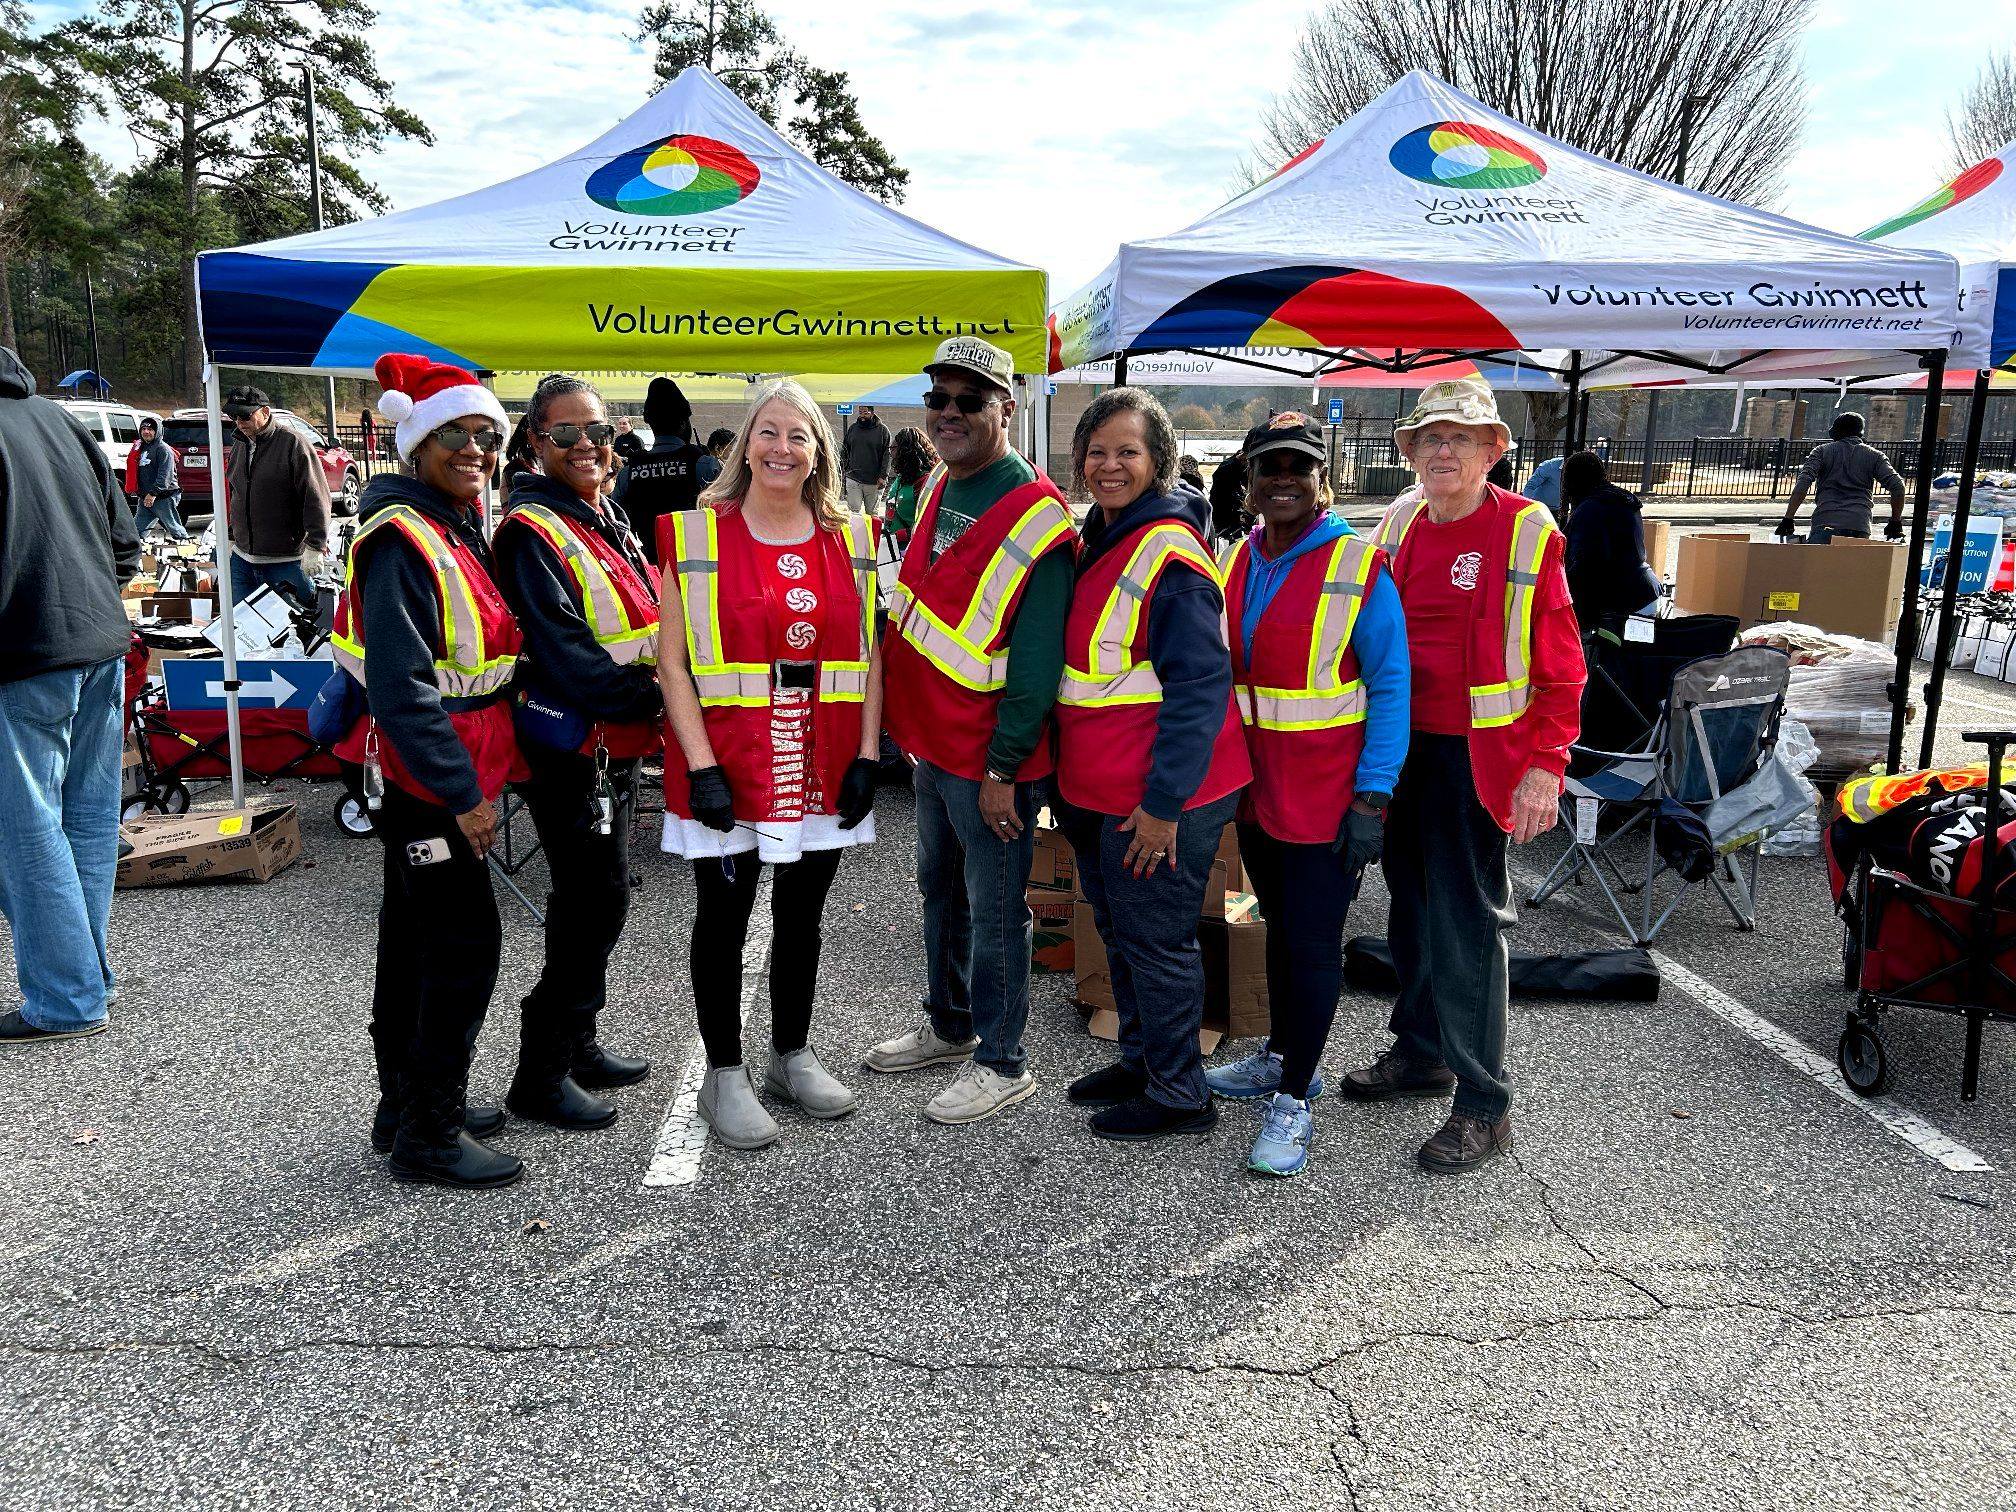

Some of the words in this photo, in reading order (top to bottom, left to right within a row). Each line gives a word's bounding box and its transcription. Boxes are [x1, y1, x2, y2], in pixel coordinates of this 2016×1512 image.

[1414, 195, 1586, 212] Volunteer
[1424, 209, 1591, 226] Gwinnett
[564, 221, 746, 238] Volunteer
[549, 235, 737, 252] Gwinnett
[1533, 283, 1735, 307] Volunteer
[1747, 280, 1929, 309] Gwinnett
[1682, 314, 1925, 332] VolunteerGwinnett.net
[946, 342, 995, 367] Harlem
[630, 465, 687, 480] POLICE
[527, 700, 565, 720] Gwinnett
[220, 837, 252, 853] 13539
